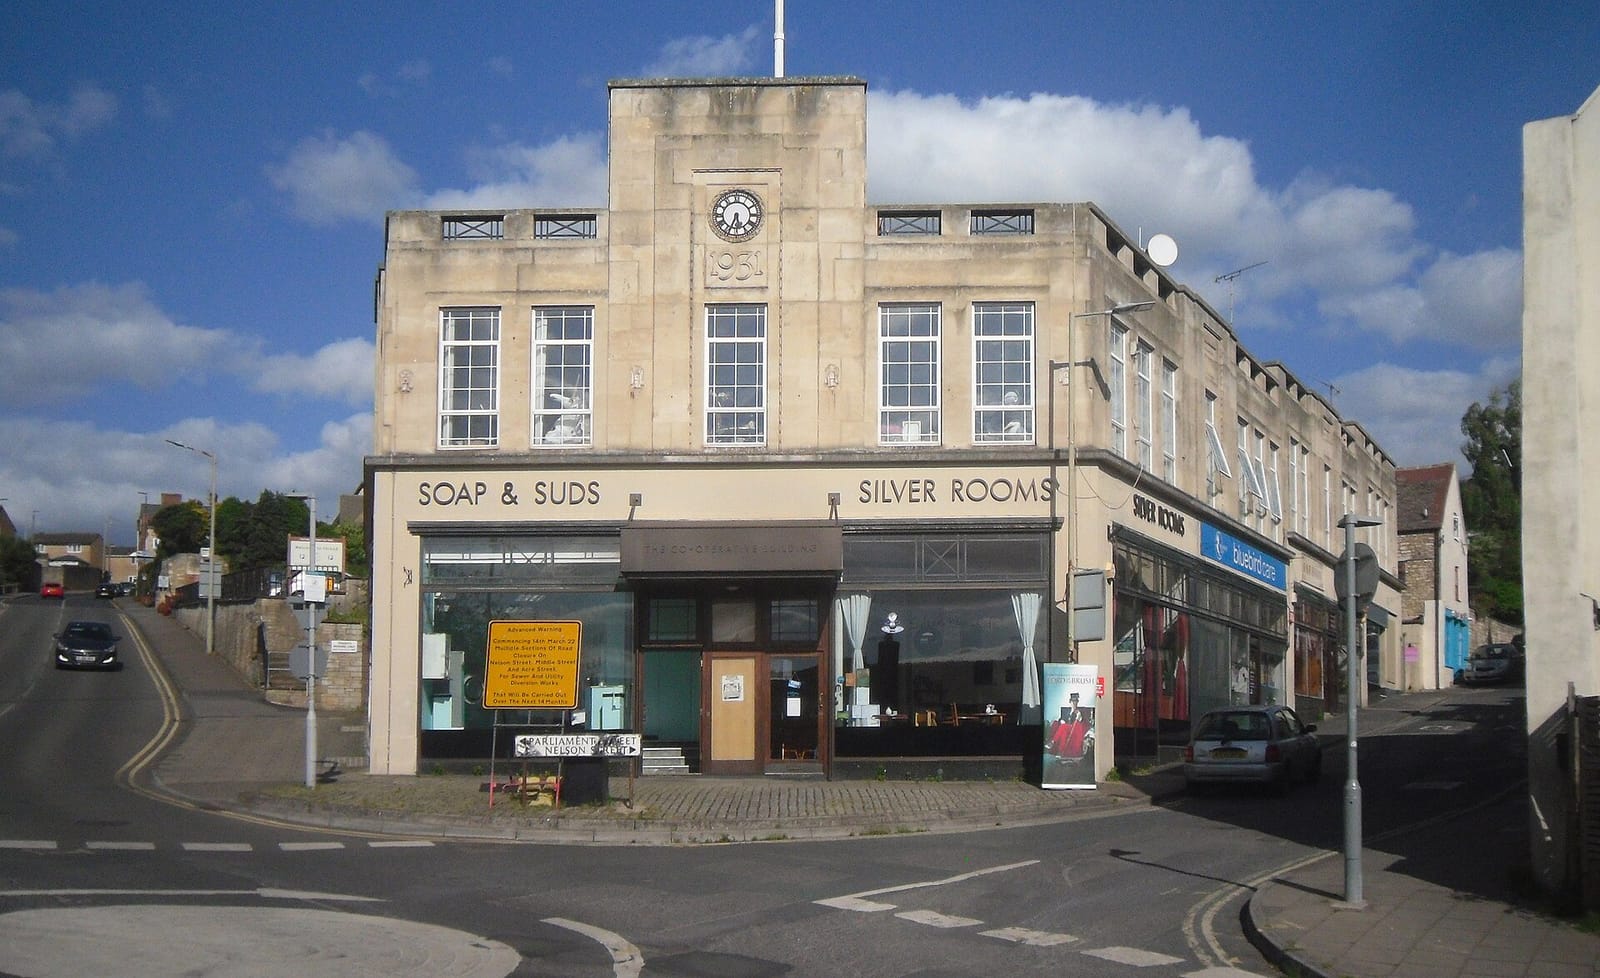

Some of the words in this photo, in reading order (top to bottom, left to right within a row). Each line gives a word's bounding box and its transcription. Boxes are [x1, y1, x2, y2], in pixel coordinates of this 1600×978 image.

[710, 250, 763, 281] 1931
[418, 481, 487, 506] SOAP
[501, 482, 519, 505] &
[534, 480, 600, 506] SUDS
[858, 478, 936, 504] SILVER
[951, 477, 1054, 503] ROOMS
[1132, 493, 1156, 523] SILVER
[1158, 505, 1185, 537] ROOMS
[1232, 542, 1262, 575] bluebird
[1262, 560, 1276, 582] care
[529, 736, 596, 746] PARLIAMENT
[545, 746, 586, 755] NELSON
